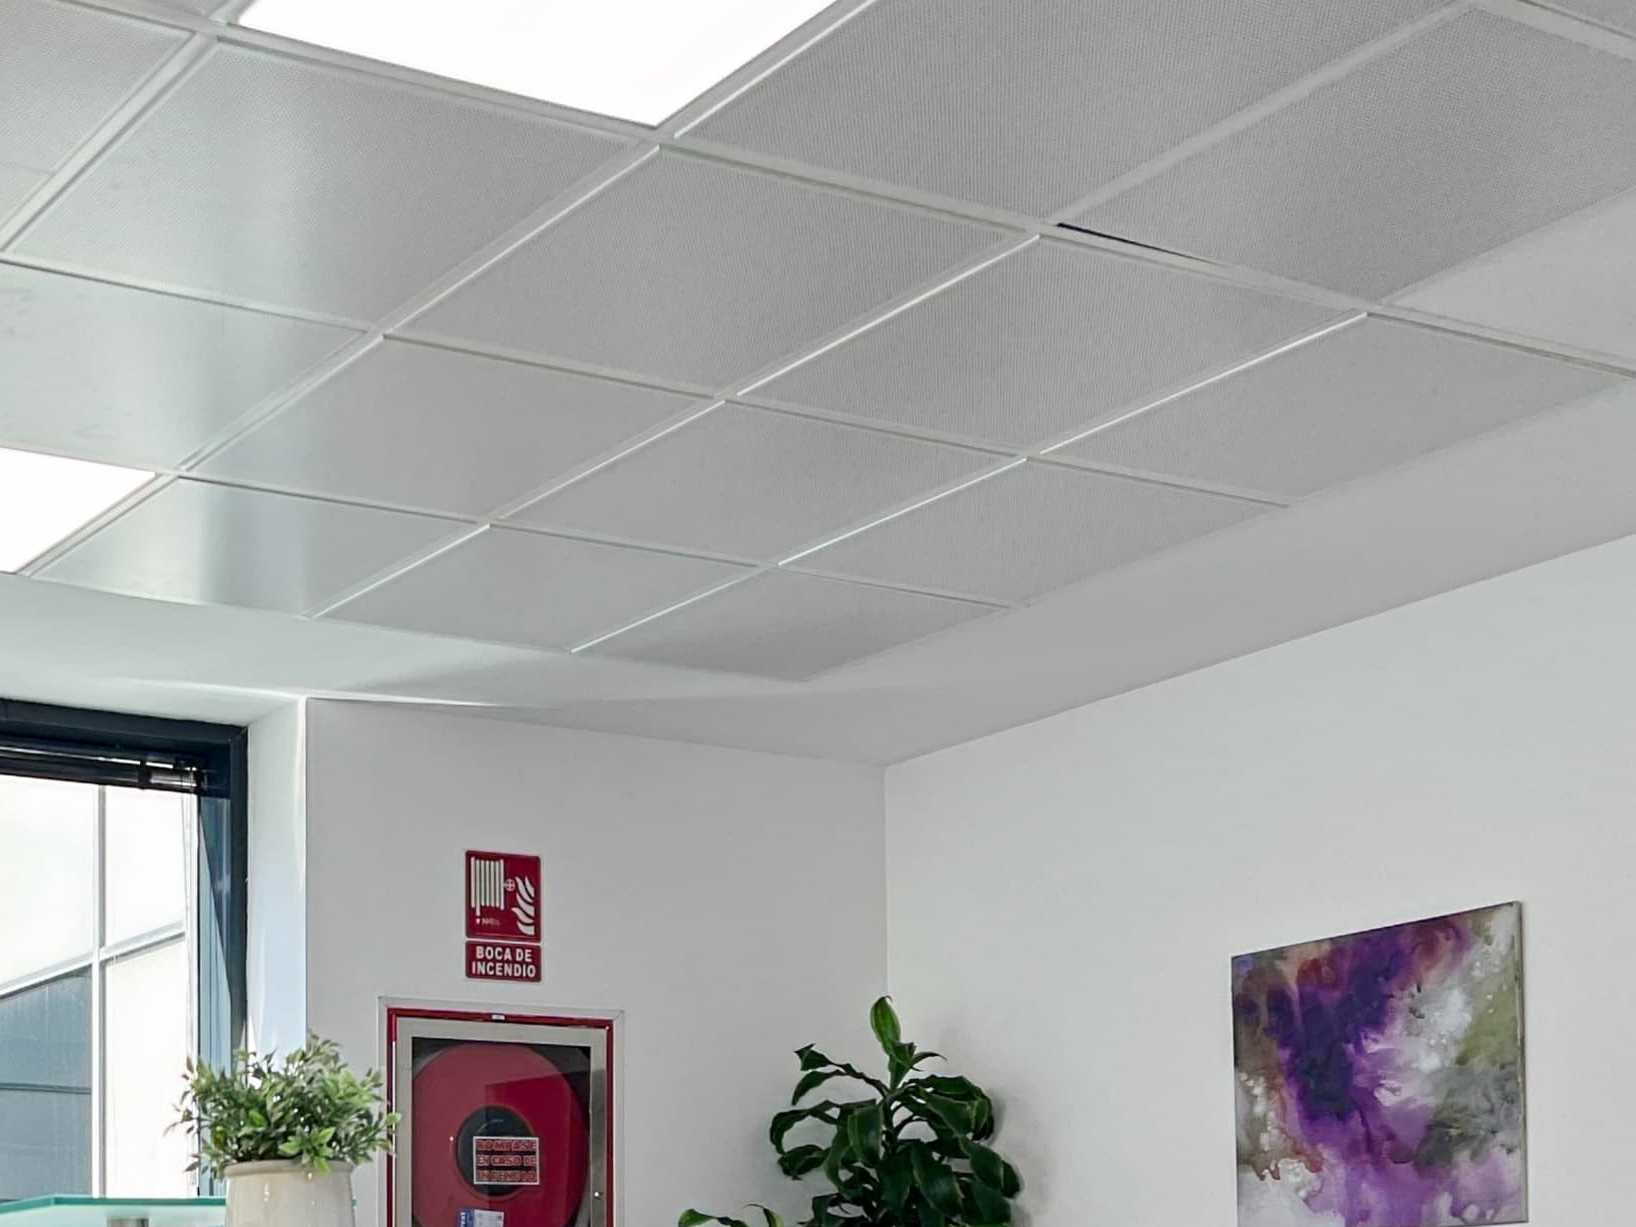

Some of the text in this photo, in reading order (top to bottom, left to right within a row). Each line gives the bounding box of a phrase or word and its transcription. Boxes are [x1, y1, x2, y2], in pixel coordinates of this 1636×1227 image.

[476, 946, 532, 962] BOCA DE
[471, 961, 536, 977] INCENDIO
[476, 1140, 537, 1151] ROMPASE
[491, 1155, 522, 1166] CASO
[524, 1155, 537, 1167] DE
